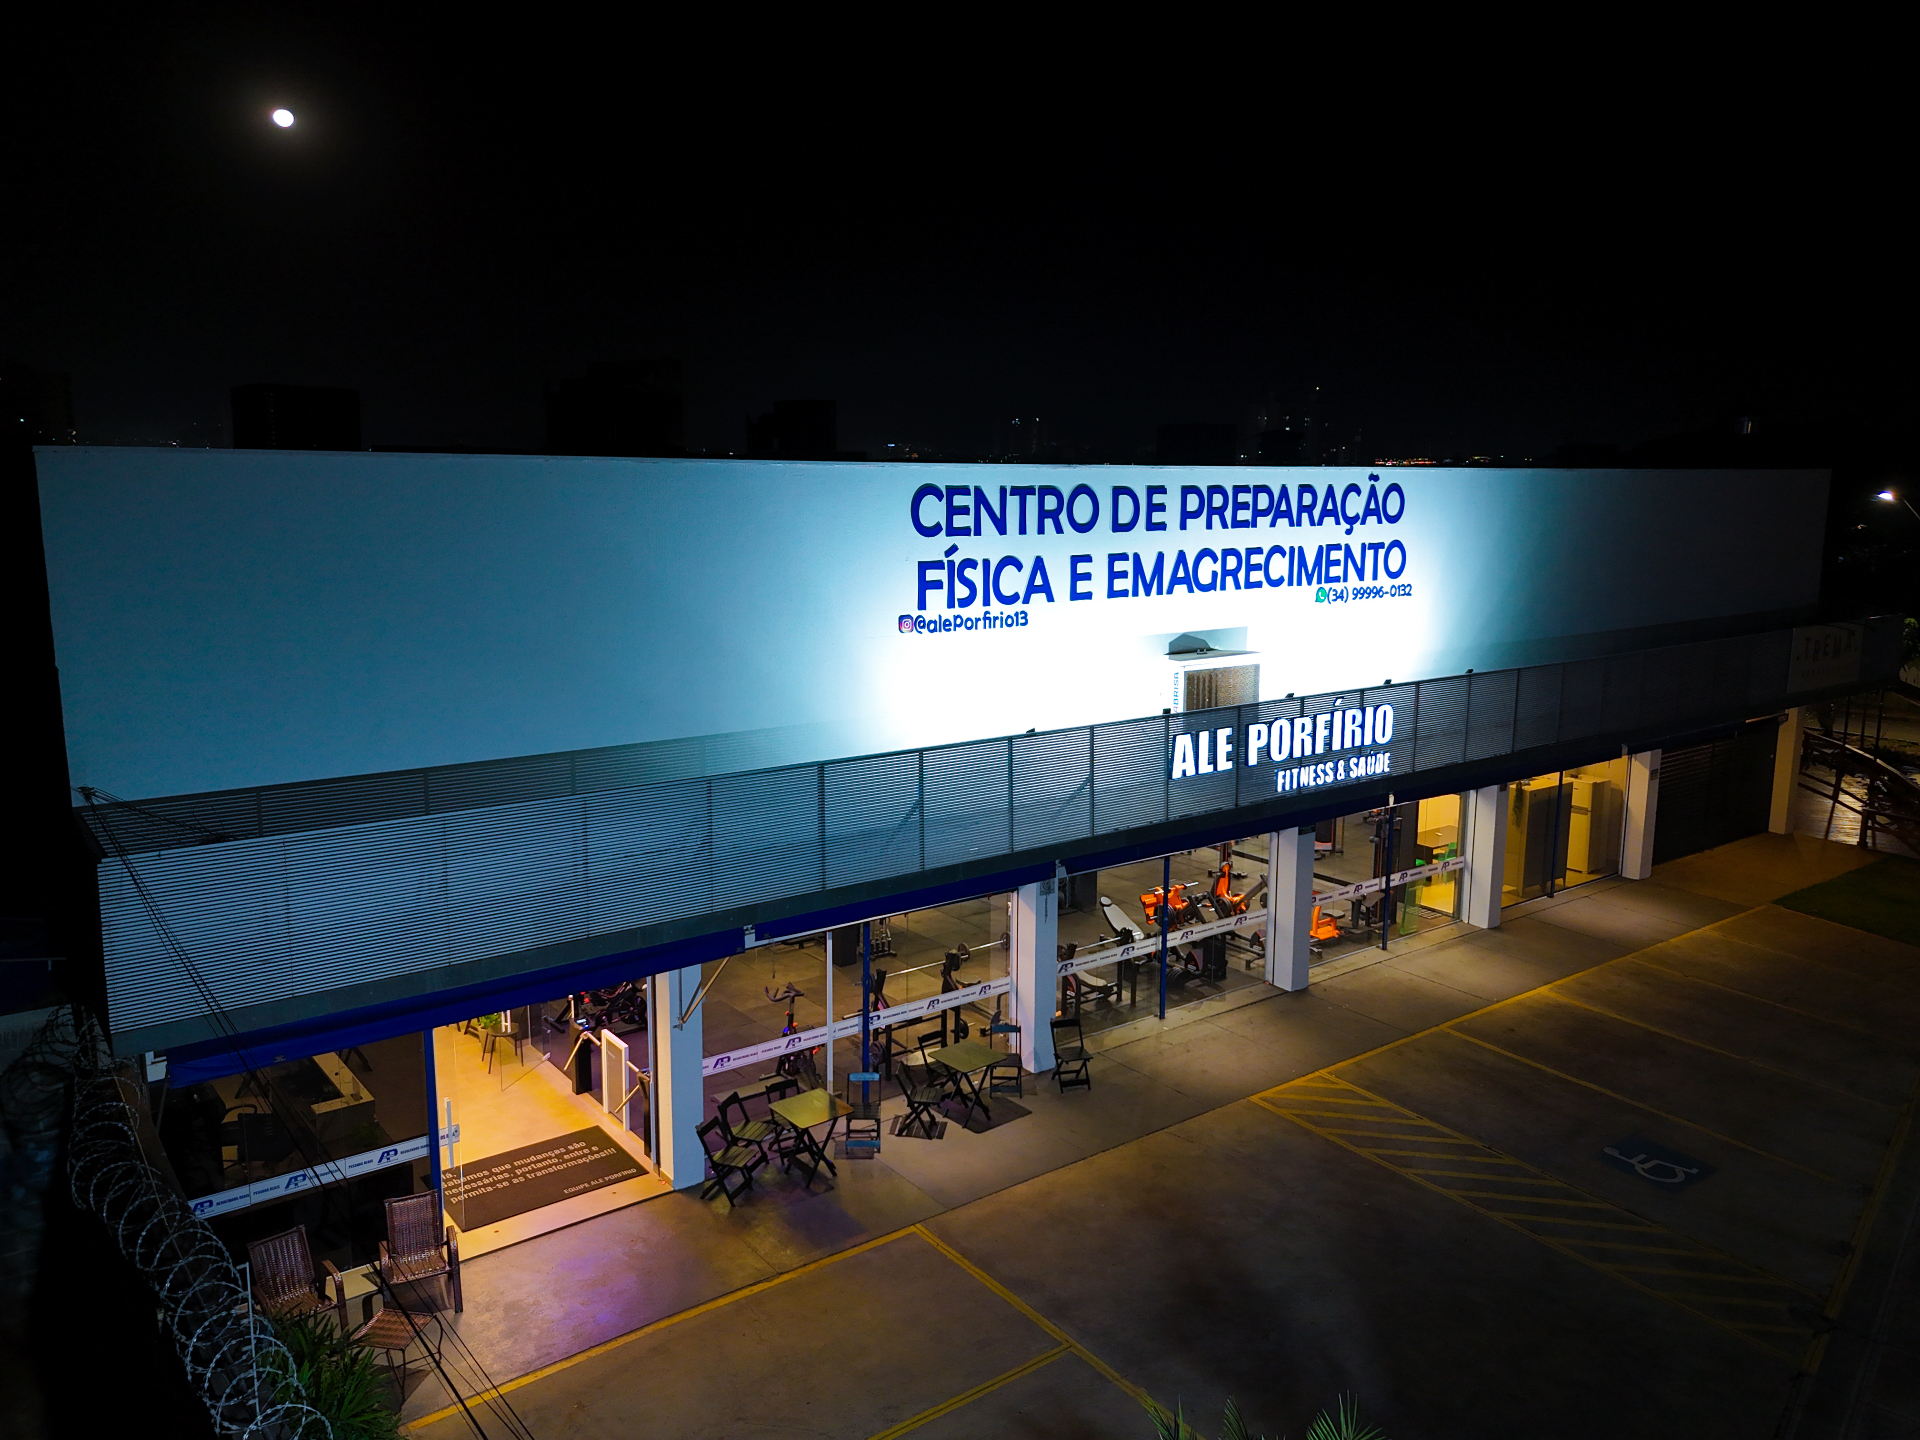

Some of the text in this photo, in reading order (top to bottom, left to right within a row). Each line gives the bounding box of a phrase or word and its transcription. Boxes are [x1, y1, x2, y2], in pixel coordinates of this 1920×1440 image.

[909, 472, 1406, 538] CENTRO DE PREPARAÇÃO
[916, 539, 1407, 611] FÍSICA E EMAGRECIMENTO
[1327, 583, 1413, 604] (34) 99996-0132
[1172, 671, 1180, 715] ABRISA
[1171, 696, 1395, 779] ALE PORFÍRIO
[1276, 750, 1391, 793] FITNESS & SAÚDE
[442, 1172, 457, 1180] lá,
[445, 1172, 514, 1196] necessárias,
[515, 1157, 563, 1176] portanto,
[564, 1148, 590, 1160] entre
[450, 1147, 618, 1204] permita-se as transformações!!!
[492, 1163, 512, 1174] que
[513, 1147, 567, 1167] mudanças
[568, 1141, 587, 1151] são
[563, 1182, 590, 1194] EQUIPE
[591, 1177, 604, 1186] ALE
